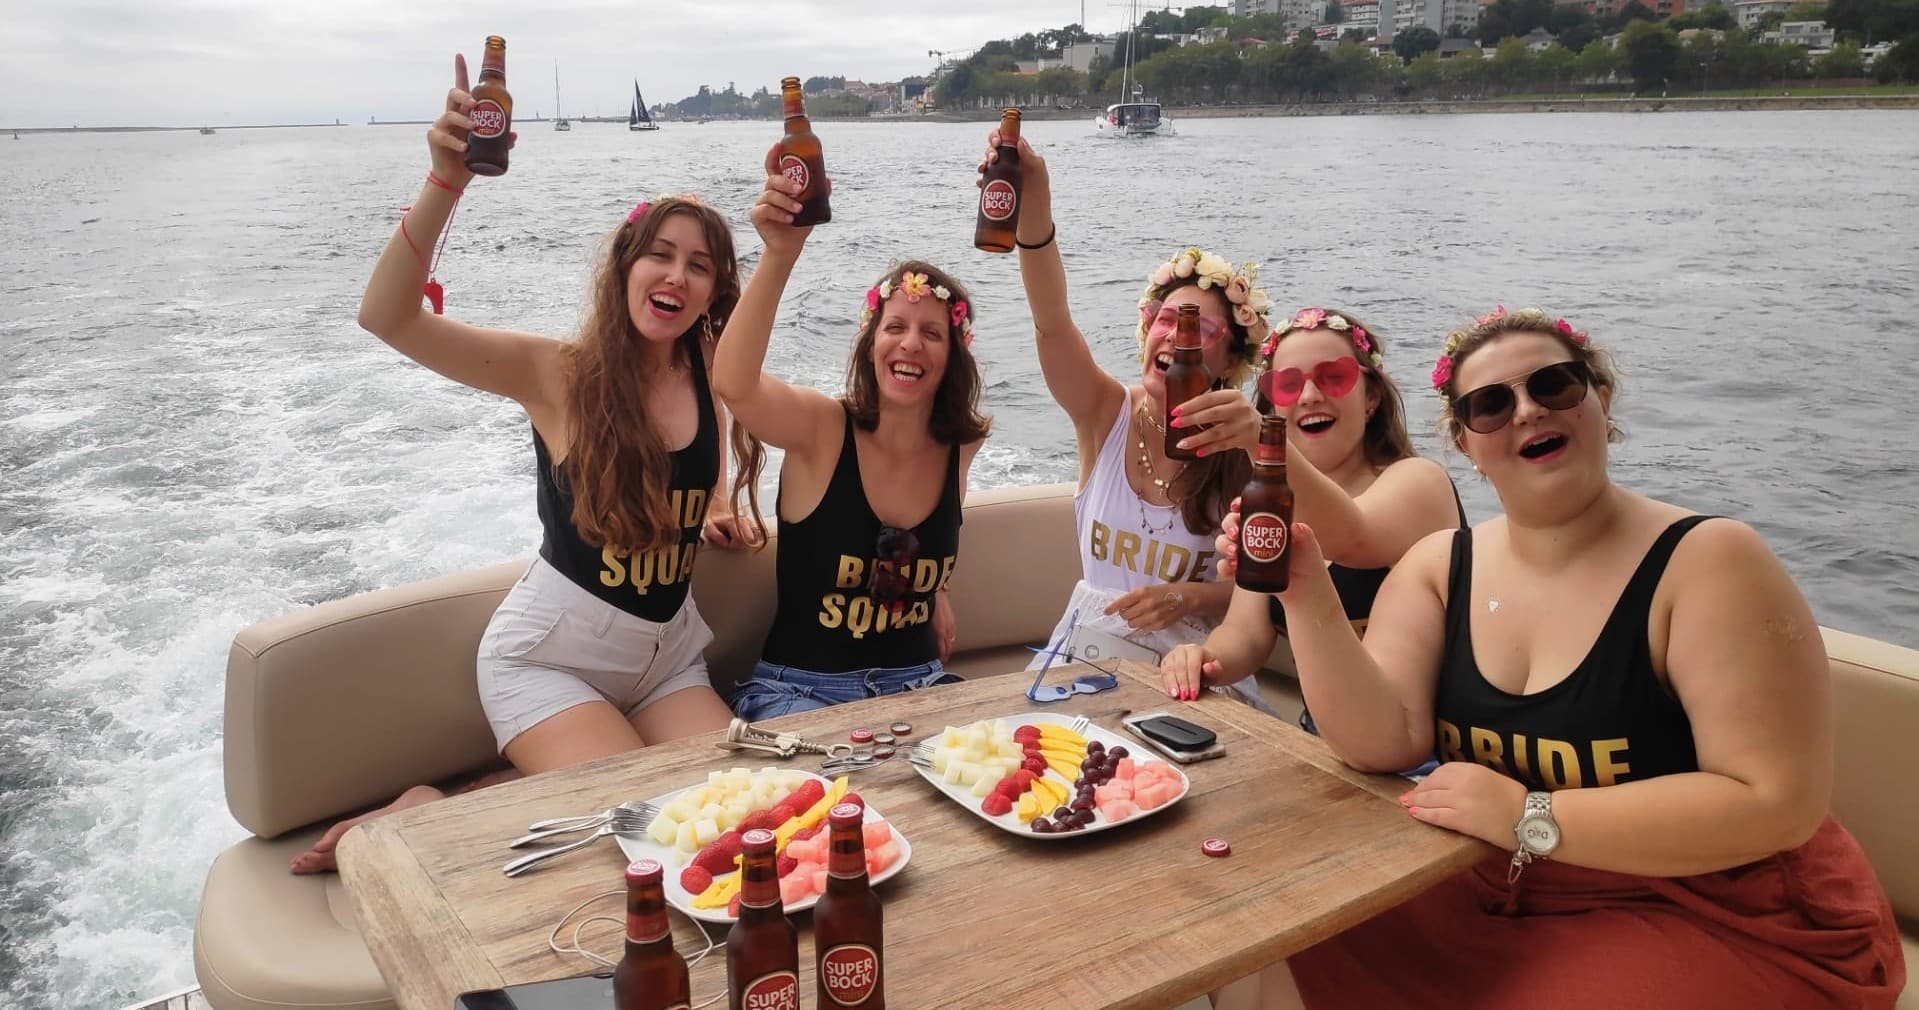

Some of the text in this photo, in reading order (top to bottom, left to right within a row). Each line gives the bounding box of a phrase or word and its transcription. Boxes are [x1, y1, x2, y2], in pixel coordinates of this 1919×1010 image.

[472, 110, 502, 122] SUPER
[985, 191, 1013, 202] SUPER
[985, 200, 1011, 210] BOCK
[1246, 525, 1283, 538] SUPER
[1247, 536, 1281, 549] BOCK
[1091, 519, 1216, 583] BRIDE
[1254, 548, 1274, 558] mini
[826, 957, 873, 976] SUPER
[829, 970, 872, 989] BOCK
[749, 983, 795, 1008] SUPER
